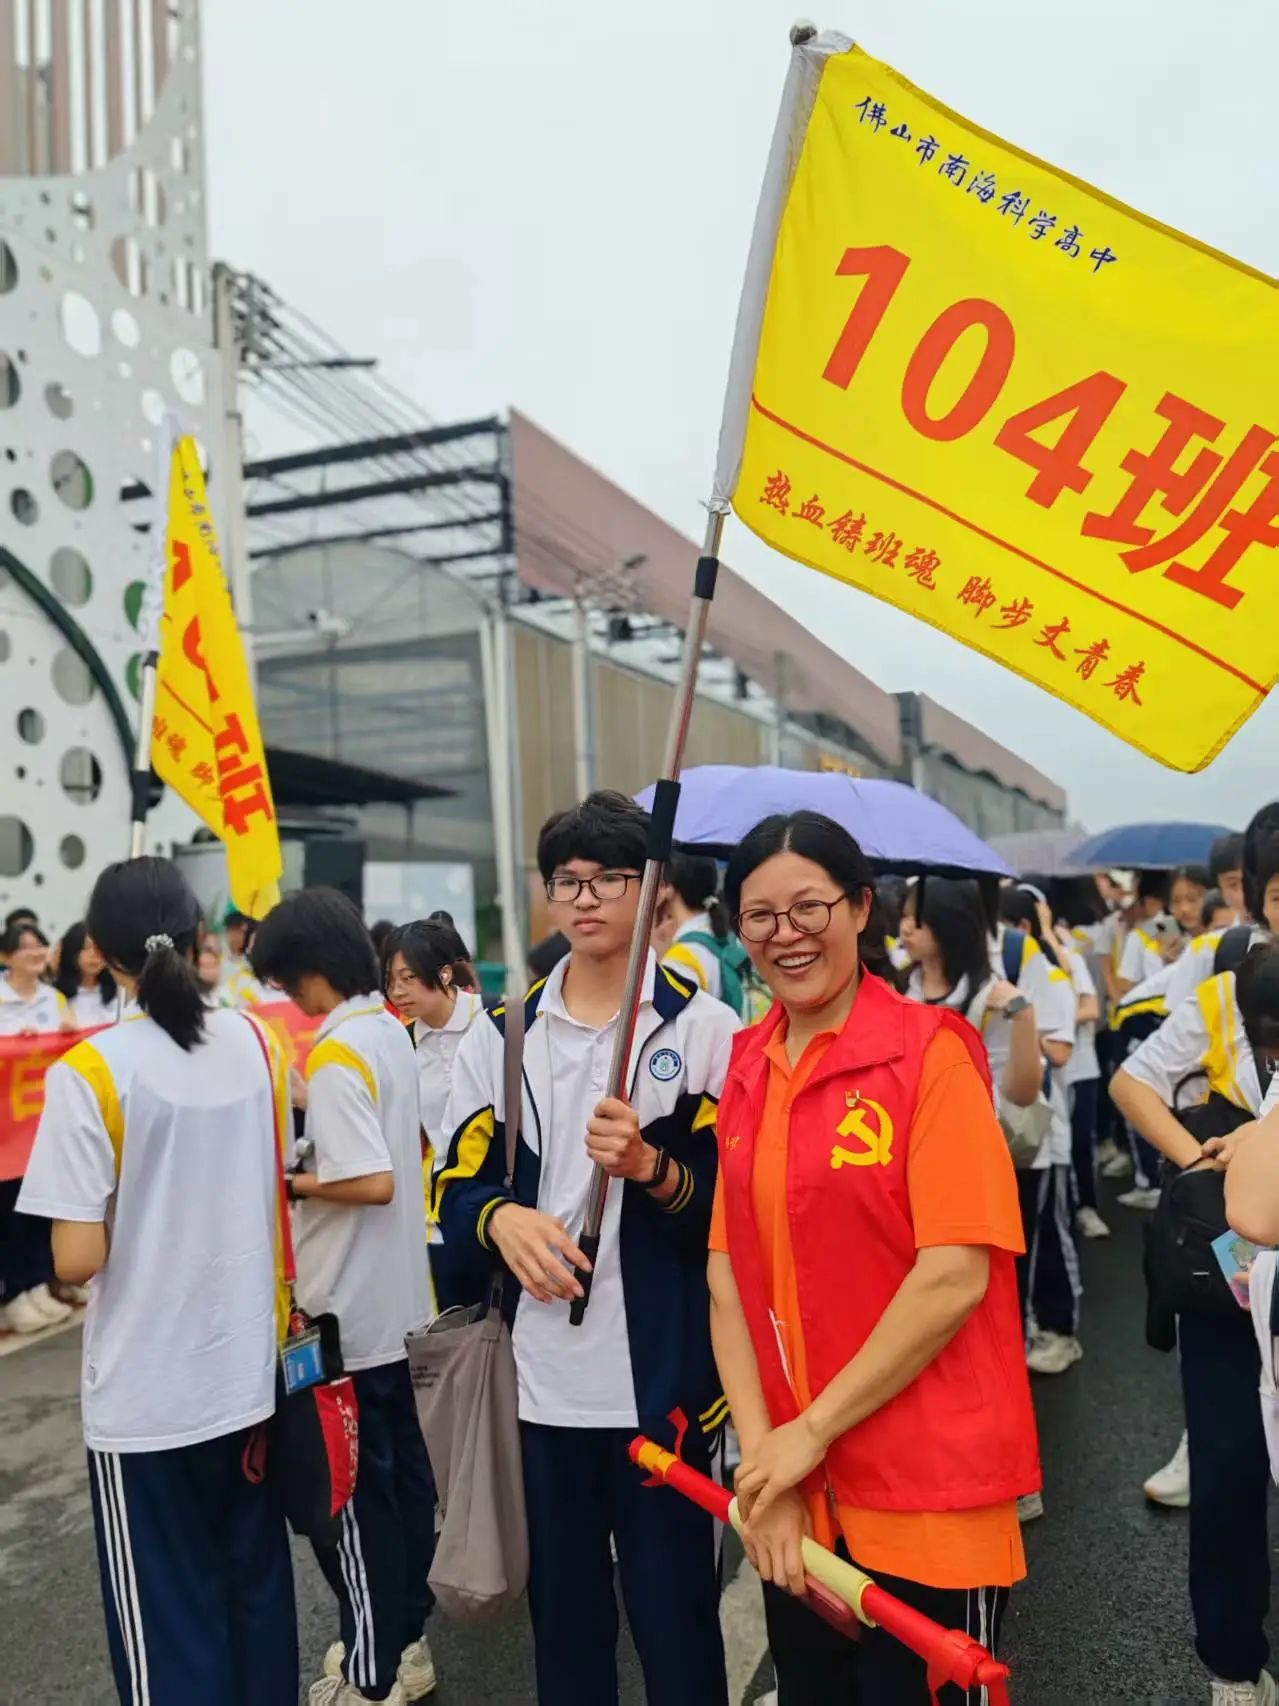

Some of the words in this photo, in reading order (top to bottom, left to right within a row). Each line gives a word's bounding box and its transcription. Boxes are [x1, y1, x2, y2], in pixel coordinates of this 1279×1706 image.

[855, 96, 1118, 273] 佛山市南海科学高中
[821, 244, 1279, 611] 104班
[759, 469, 942, 591] 热血铸班魂
